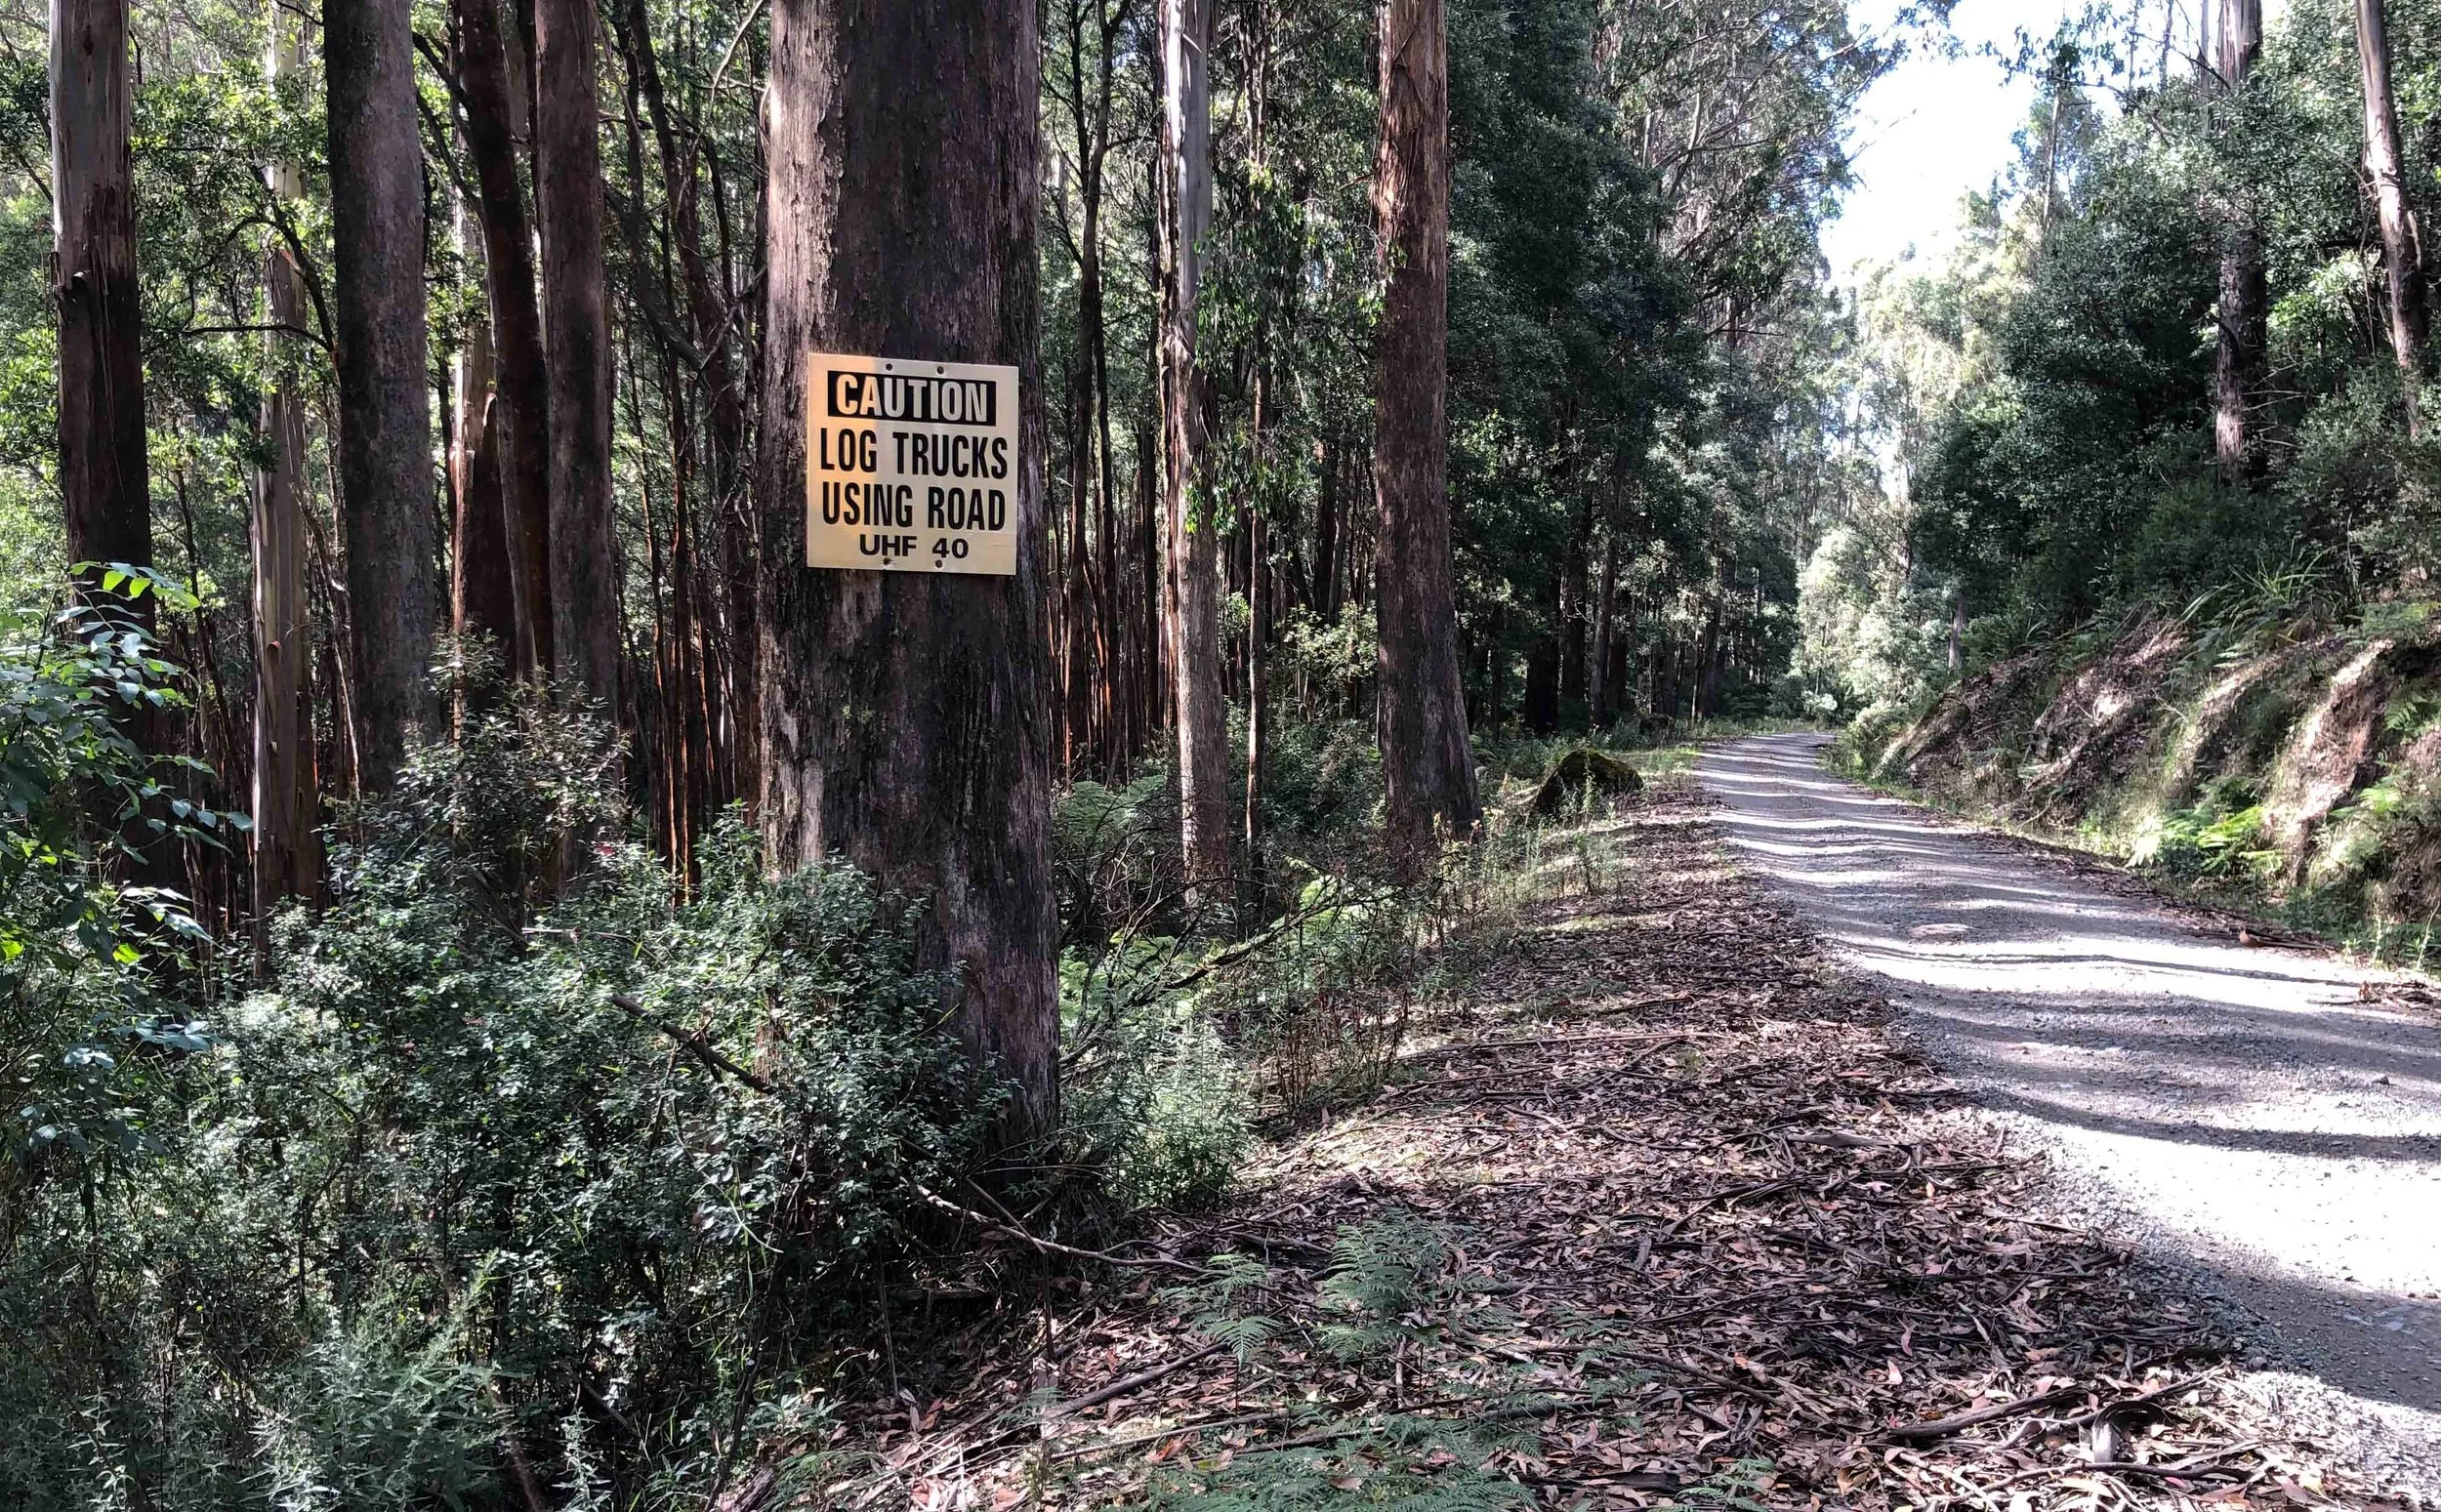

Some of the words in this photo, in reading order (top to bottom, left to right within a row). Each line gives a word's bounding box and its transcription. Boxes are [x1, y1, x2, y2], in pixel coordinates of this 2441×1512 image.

[836, 374, 987, 423] CAUTION
[820, 428, 877, 472] LOG
[892, 431, 1008, 479] TRUCKS
[822, 481, 913, 528] USING
[928, 486, 1006, 531] ROAD
[859, 534, 918, 556] UHF
[931, 538, 969, 559] 40
